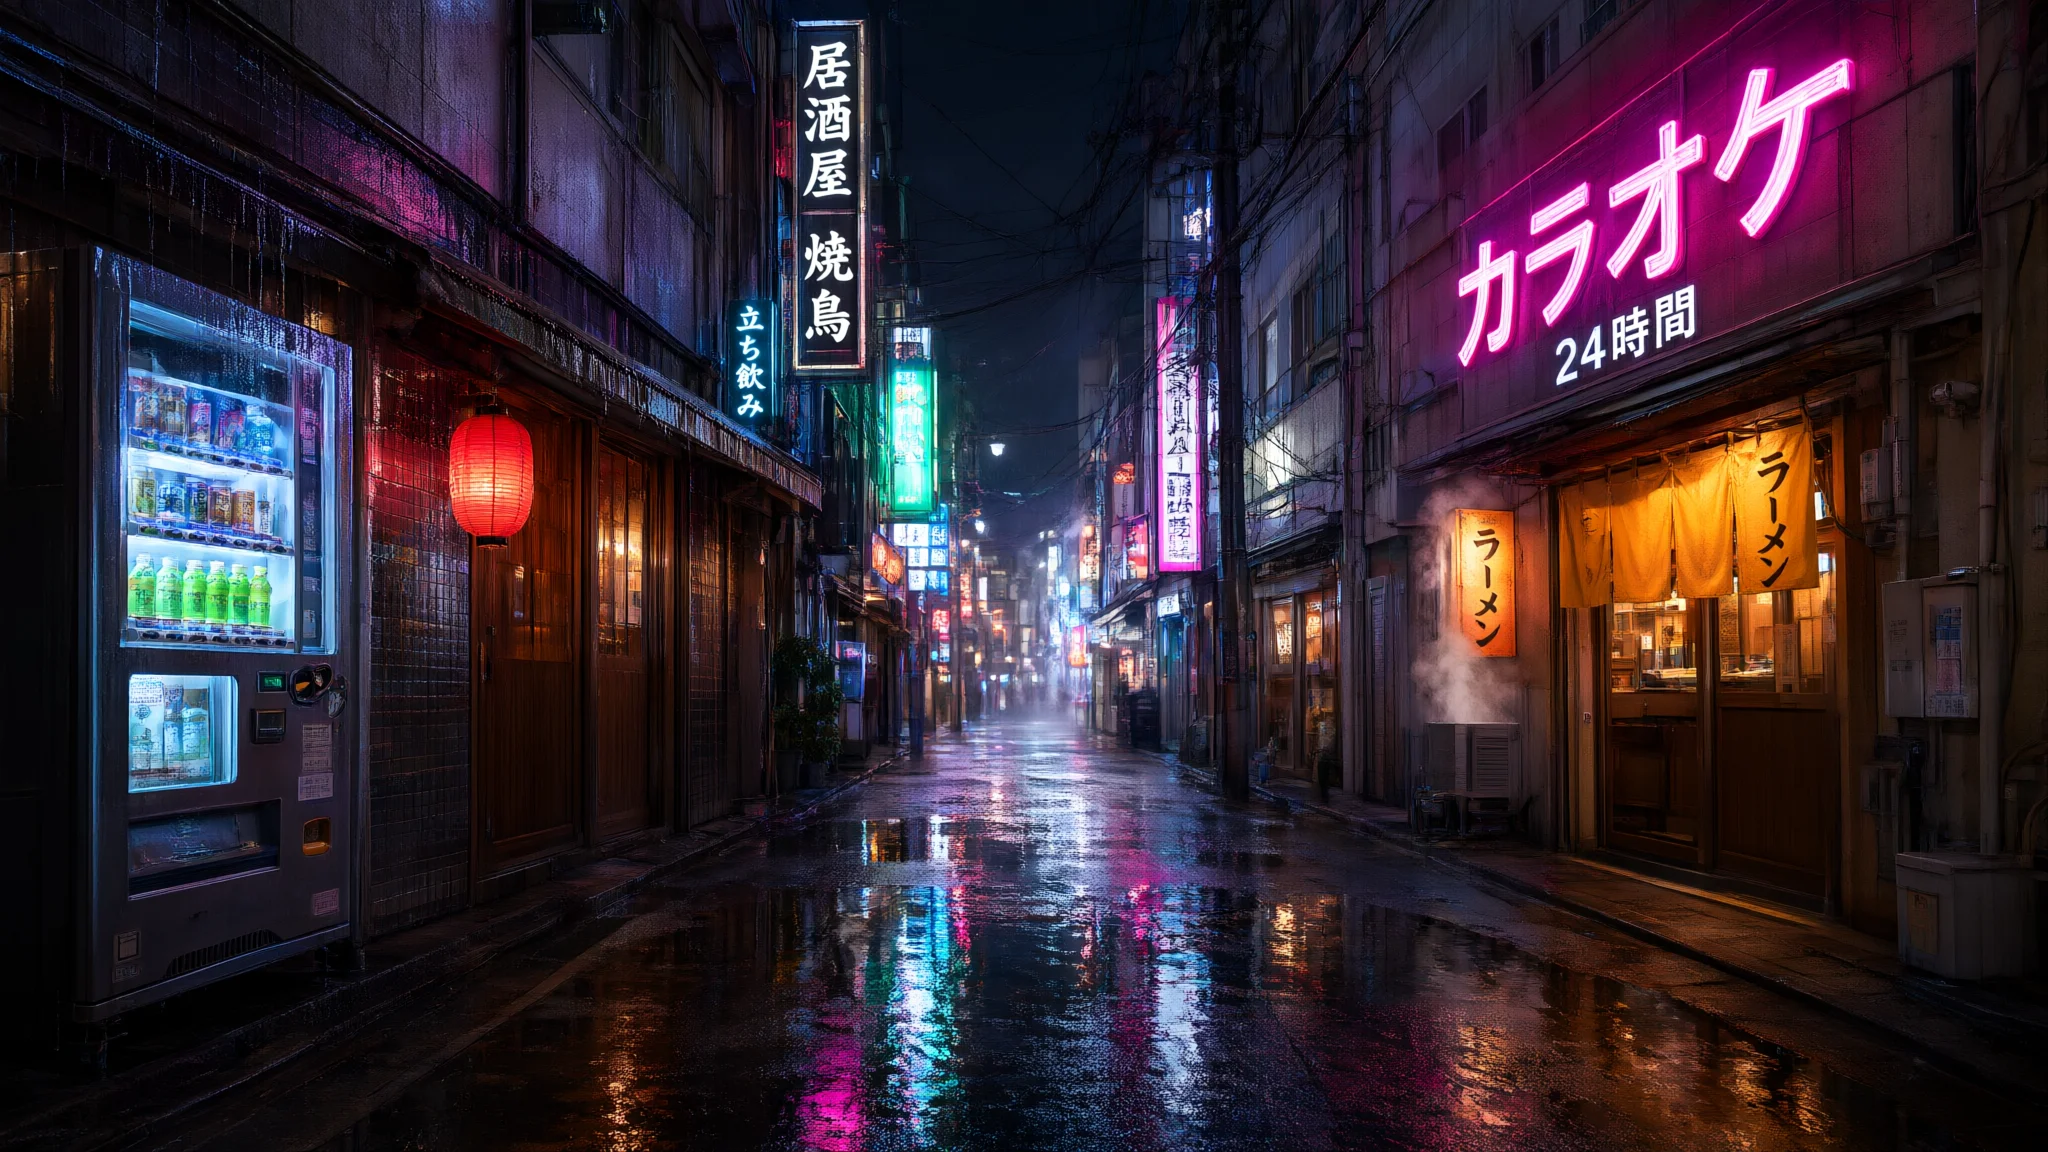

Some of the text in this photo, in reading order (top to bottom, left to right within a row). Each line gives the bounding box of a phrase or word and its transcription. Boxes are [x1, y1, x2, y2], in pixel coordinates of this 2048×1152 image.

[803, 42, 852, 198] 居酒屋
[1458, 58, 1854, 368] カラオケ
[804, 230, 854, 344] 焼鳥
[1556, 284, 1696, 386] 24時間
[736, 305, 767, 418] 立ち飲み
[1757, 451, 1791, 588] ラーメン
[1472, 527, 1501, 648] ラーメン
